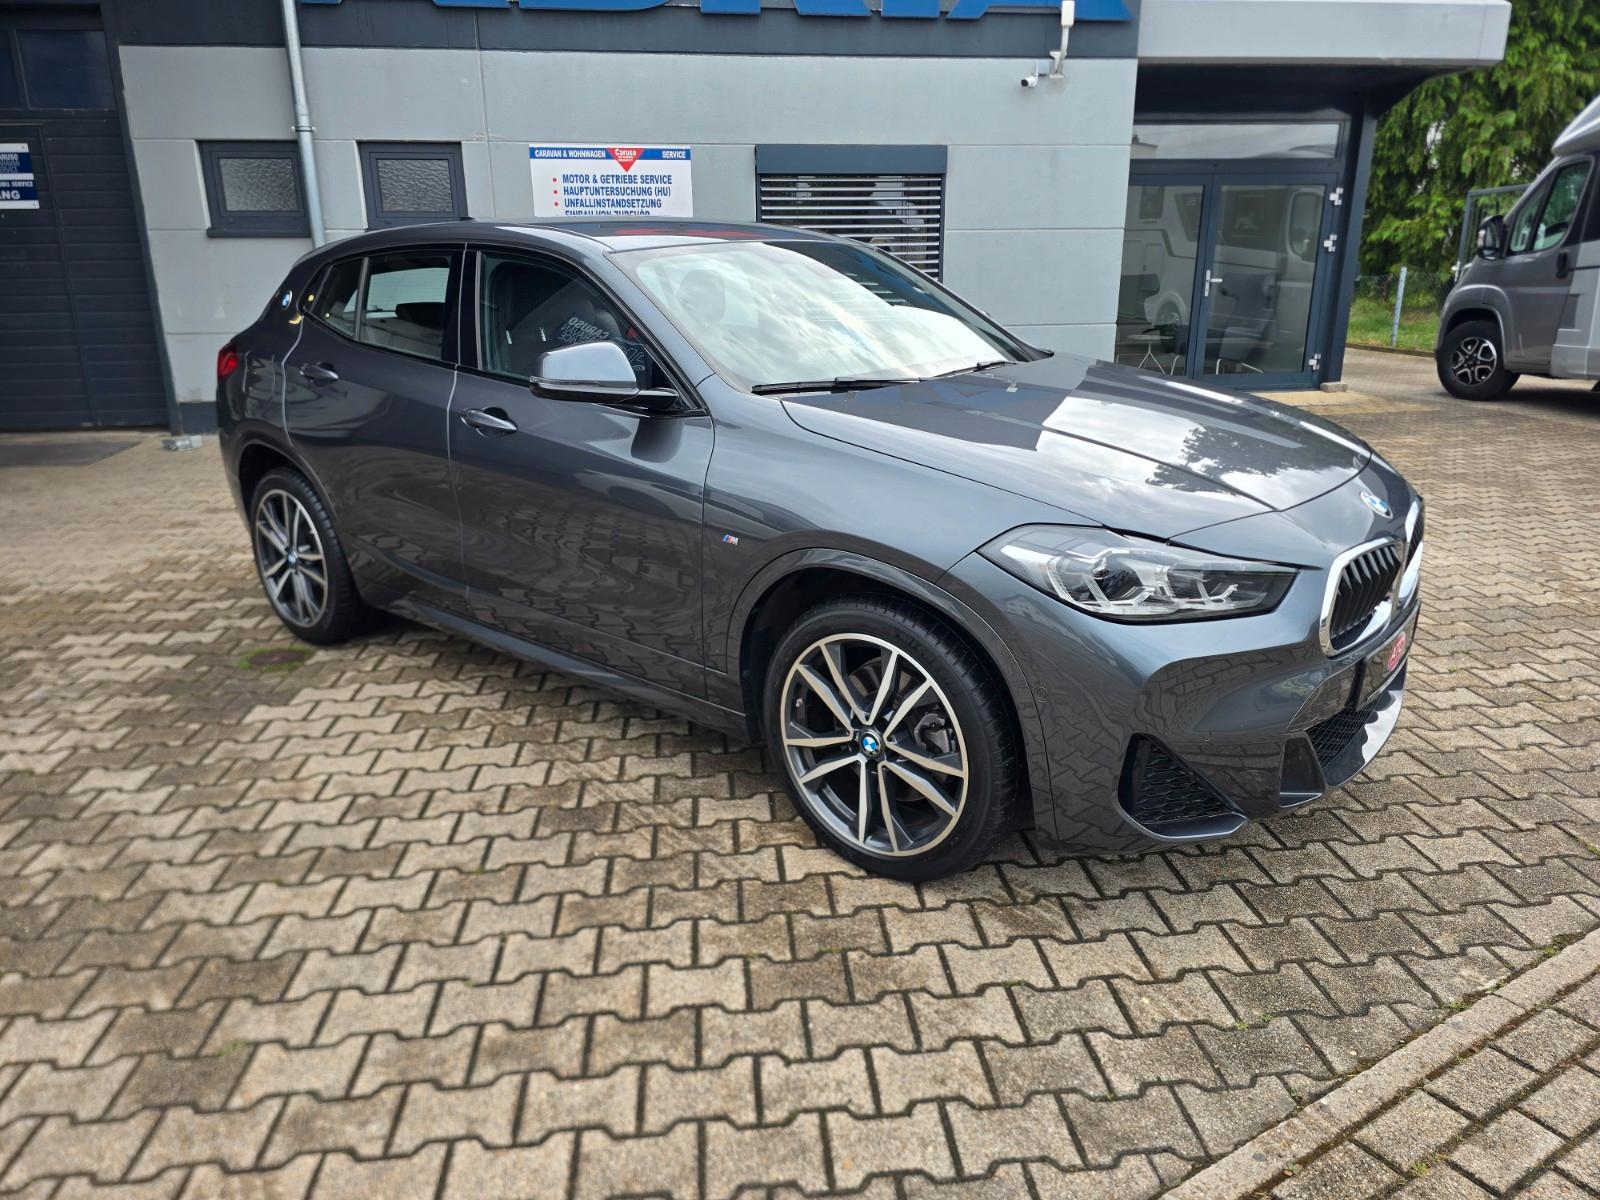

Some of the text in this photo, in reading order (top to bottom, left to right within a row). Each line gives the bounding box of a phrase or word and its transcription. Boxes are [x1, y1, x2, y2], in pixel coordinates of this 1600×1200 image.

[534, 149, 562, 158] CARAVAN
[614, 148, 637, 156] Caruso
[662, 150, 686, 159] SERVICE
[562, 174, 673, 185] MOTOR & GETRIEBE SERVICE
[0, 190, 20, 199] NG
[563, 186, 671, 197] HAUPTUNTERSUCHUNG (HU)
[564, 198, 662, 209] UNFALLINSTANDSETZUNG
